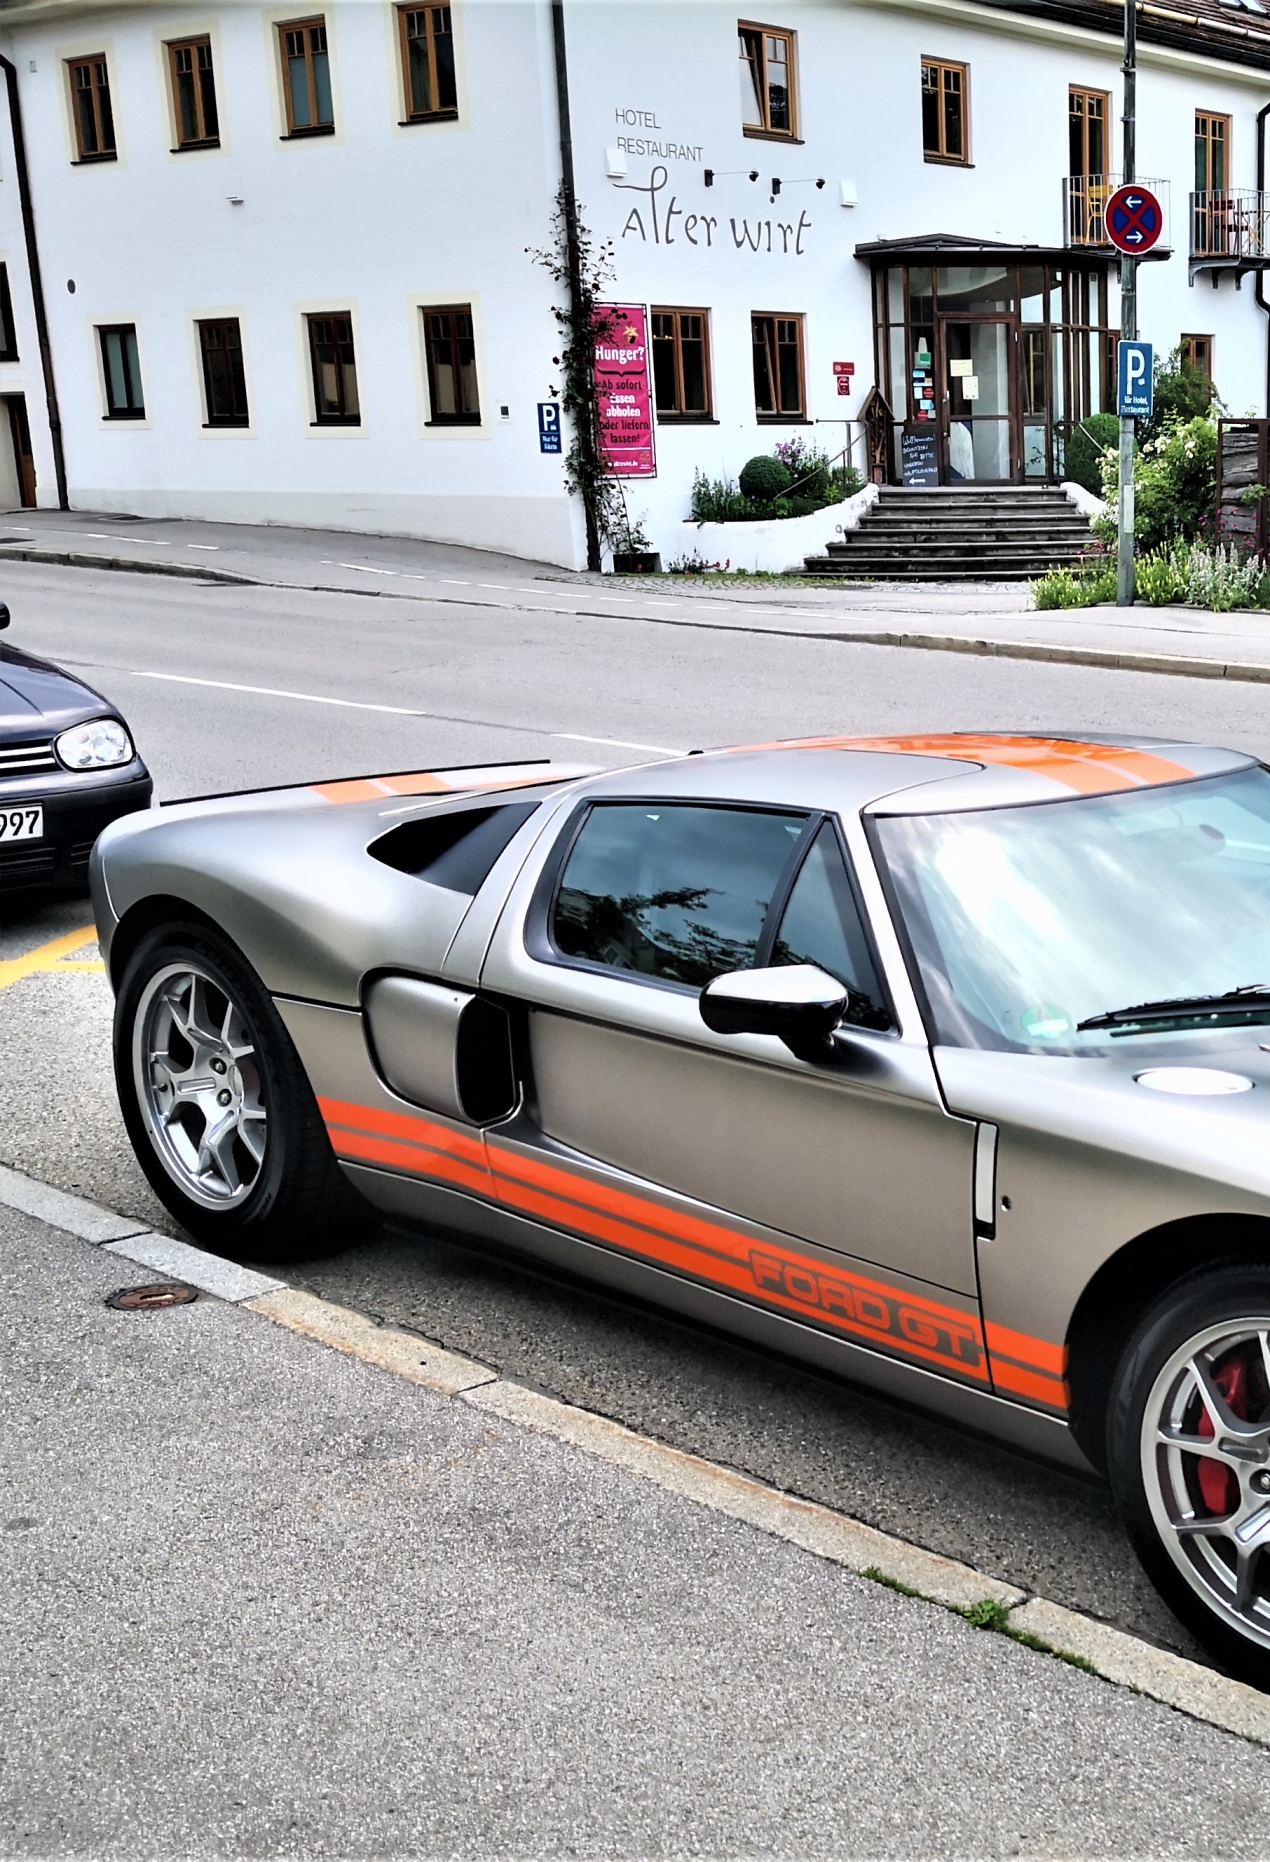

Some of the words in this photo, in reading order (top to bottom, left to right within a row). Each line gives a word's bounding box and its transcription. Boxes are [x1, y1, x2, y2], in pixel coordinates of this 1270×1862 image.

[615, 108, 661, 129] HOTEL
[617, 137, 703, 162] RESTAURANT
[612, 166, 717, 247] Alter
[595, 345, 645, 365] Hunger?
[1126, 348, 1146, 395] P
[616, 379, 642, 390] sofort
[543, 404, 556, 431] P
[606, 405, 641, 417] abholen
[621, 420, 649, 430] liefern
[610, 432, 640, 443] lassen!
[751, 1254, 891, 1331] FORD
[900, 1307, 976, 1356] GT
